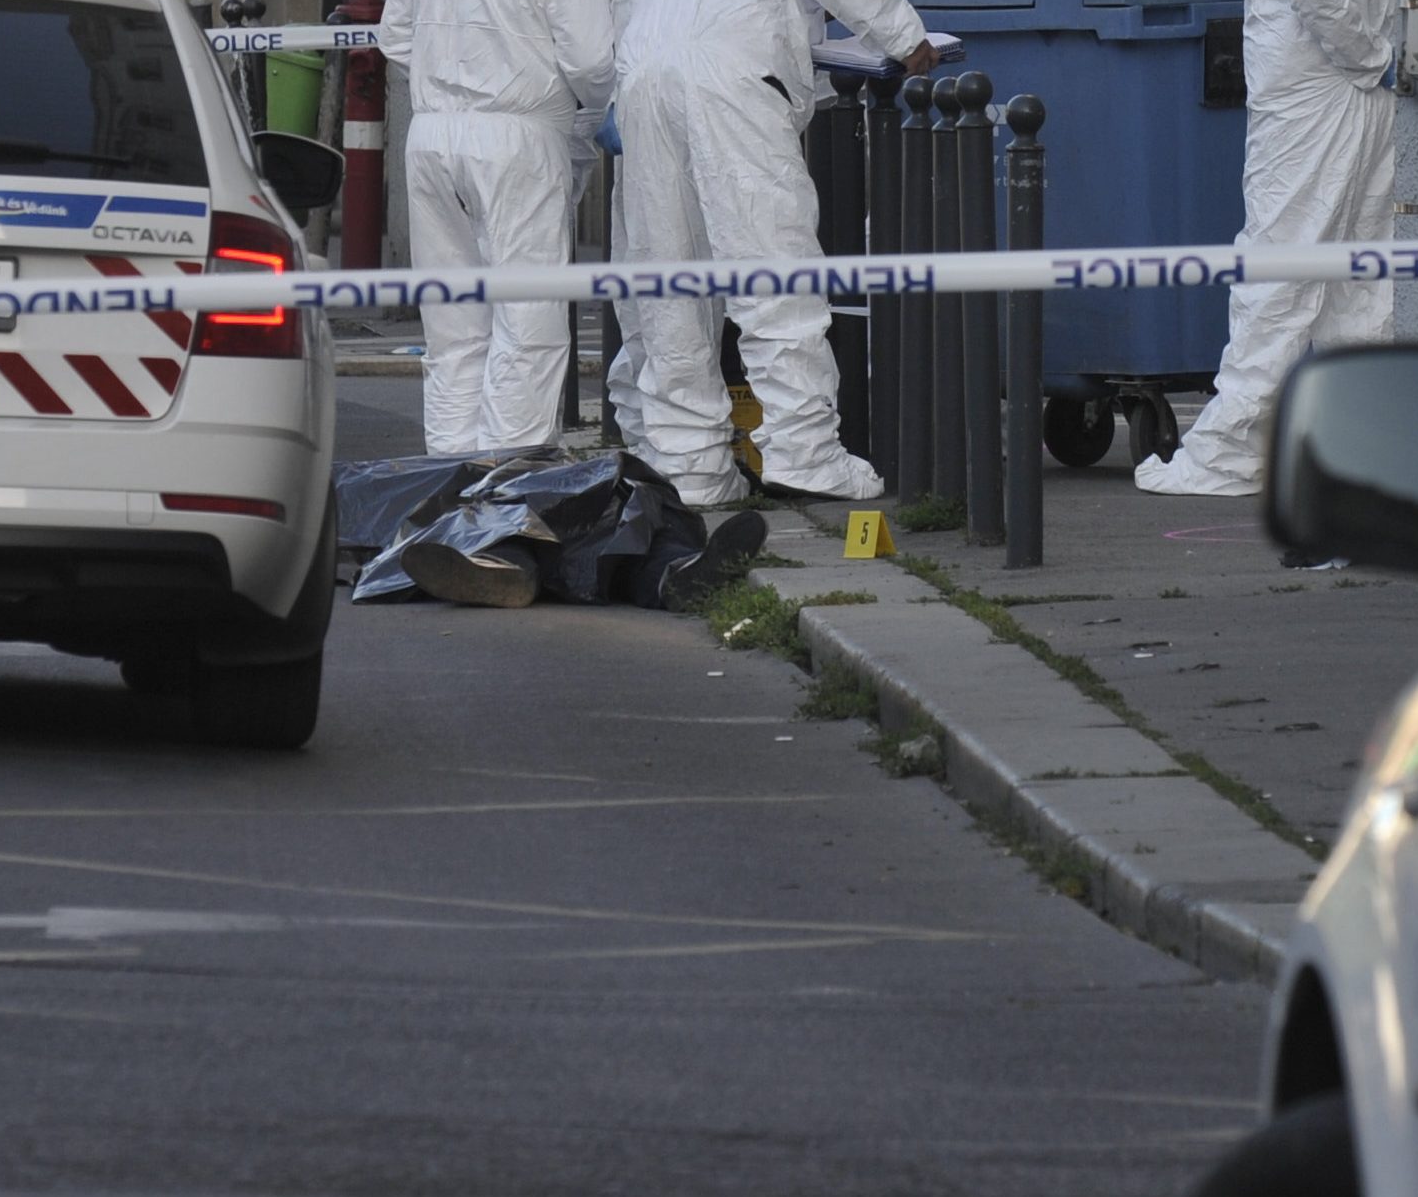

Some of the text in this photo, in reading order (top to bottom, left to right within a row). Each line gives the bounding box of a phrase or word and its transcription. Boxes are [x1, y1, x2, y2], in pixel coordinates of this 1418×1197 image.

[93, 225, 195, 245] OCTAVIA
[1053, 255, 1245, 289] POLICE
[860, 521, 869, 545] 5
